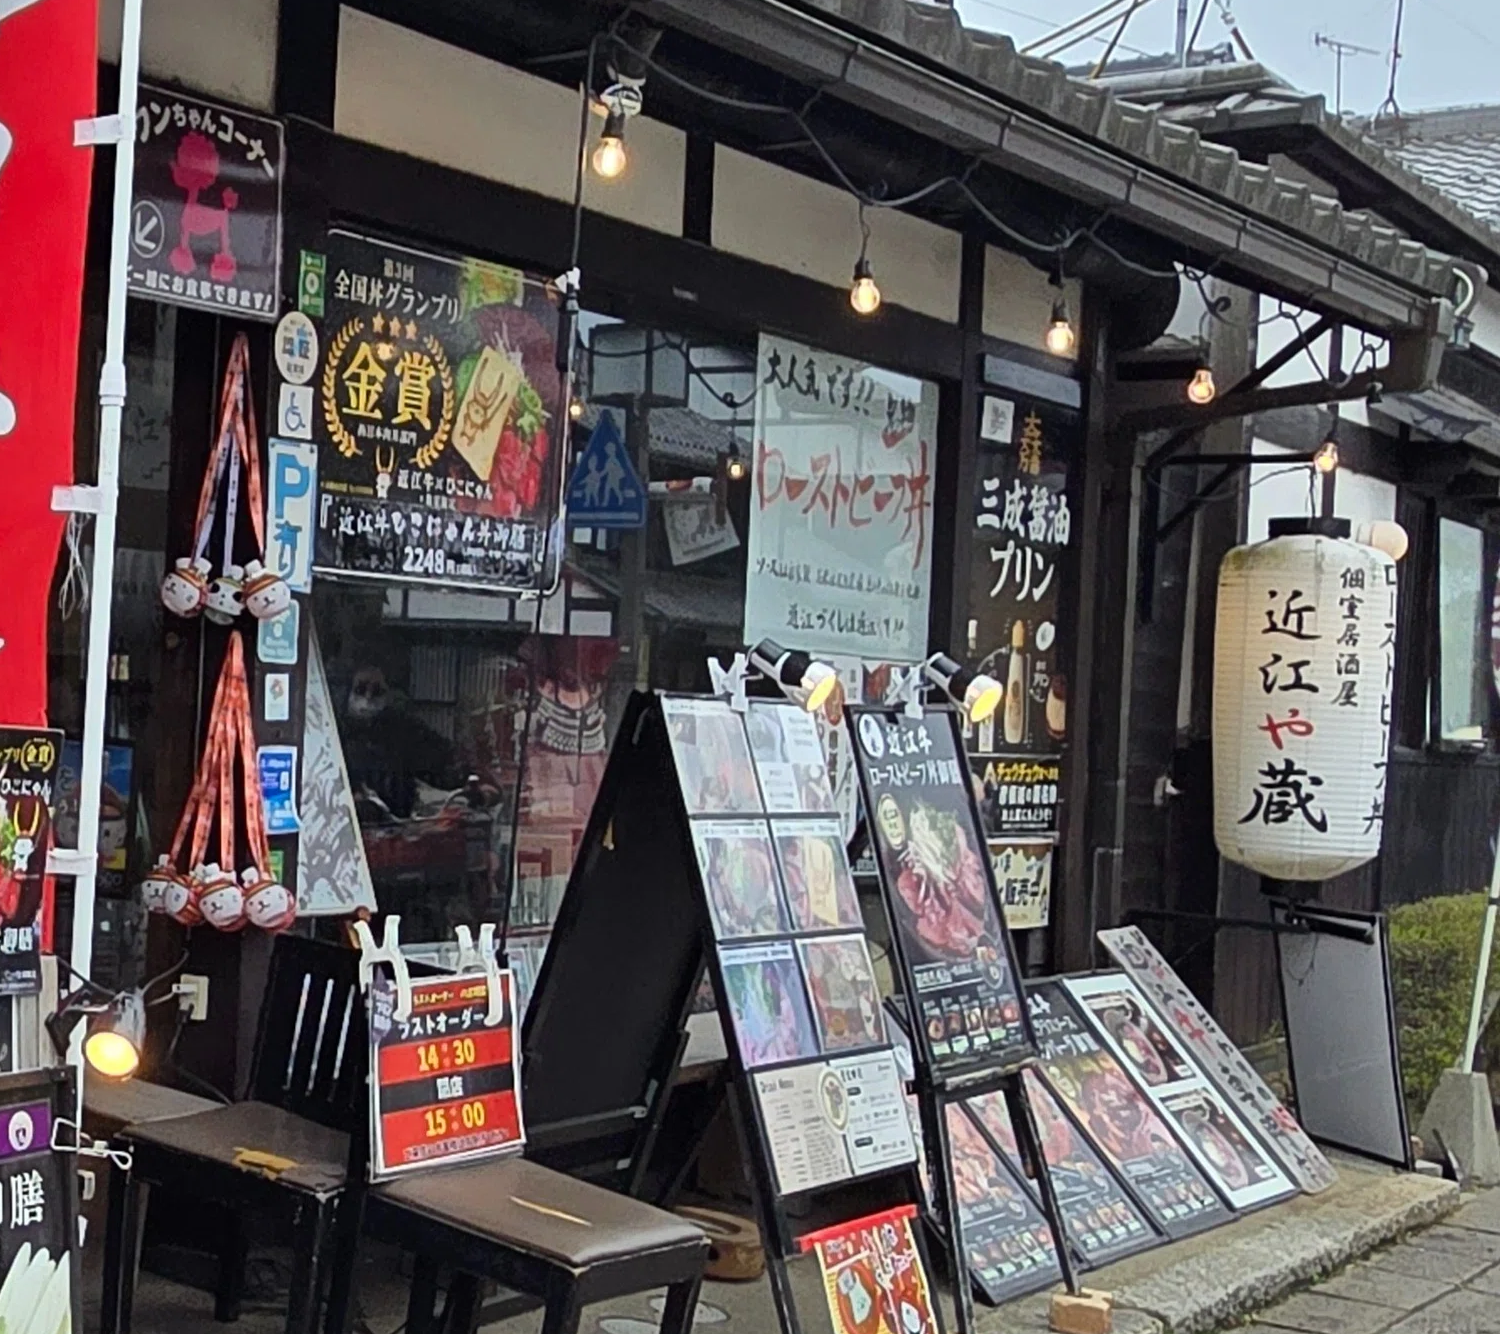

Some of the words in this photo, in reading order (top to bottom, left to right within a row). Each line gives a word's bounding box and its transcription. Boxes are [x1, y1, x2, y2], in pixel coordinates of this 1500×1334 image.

[334, 269, 463, 324] 全国丼グランプリ
[341, 341, 437, 431] 金賞
[976, 477, 1070, 545] 三成醤油
[990, 539, 1054, 602] プリン
[1331, 566, 1365, 708] 個室居酒屋
[887, 725, 932, 757] 近江牛
[1238, 589, 1328, 834] 近江や蔵
[398, 1005, 485, 1040] ラストオーダー
[417, 1038, 475, 1072] 14:30
[425, 1101, 485, 1137] 15:00
